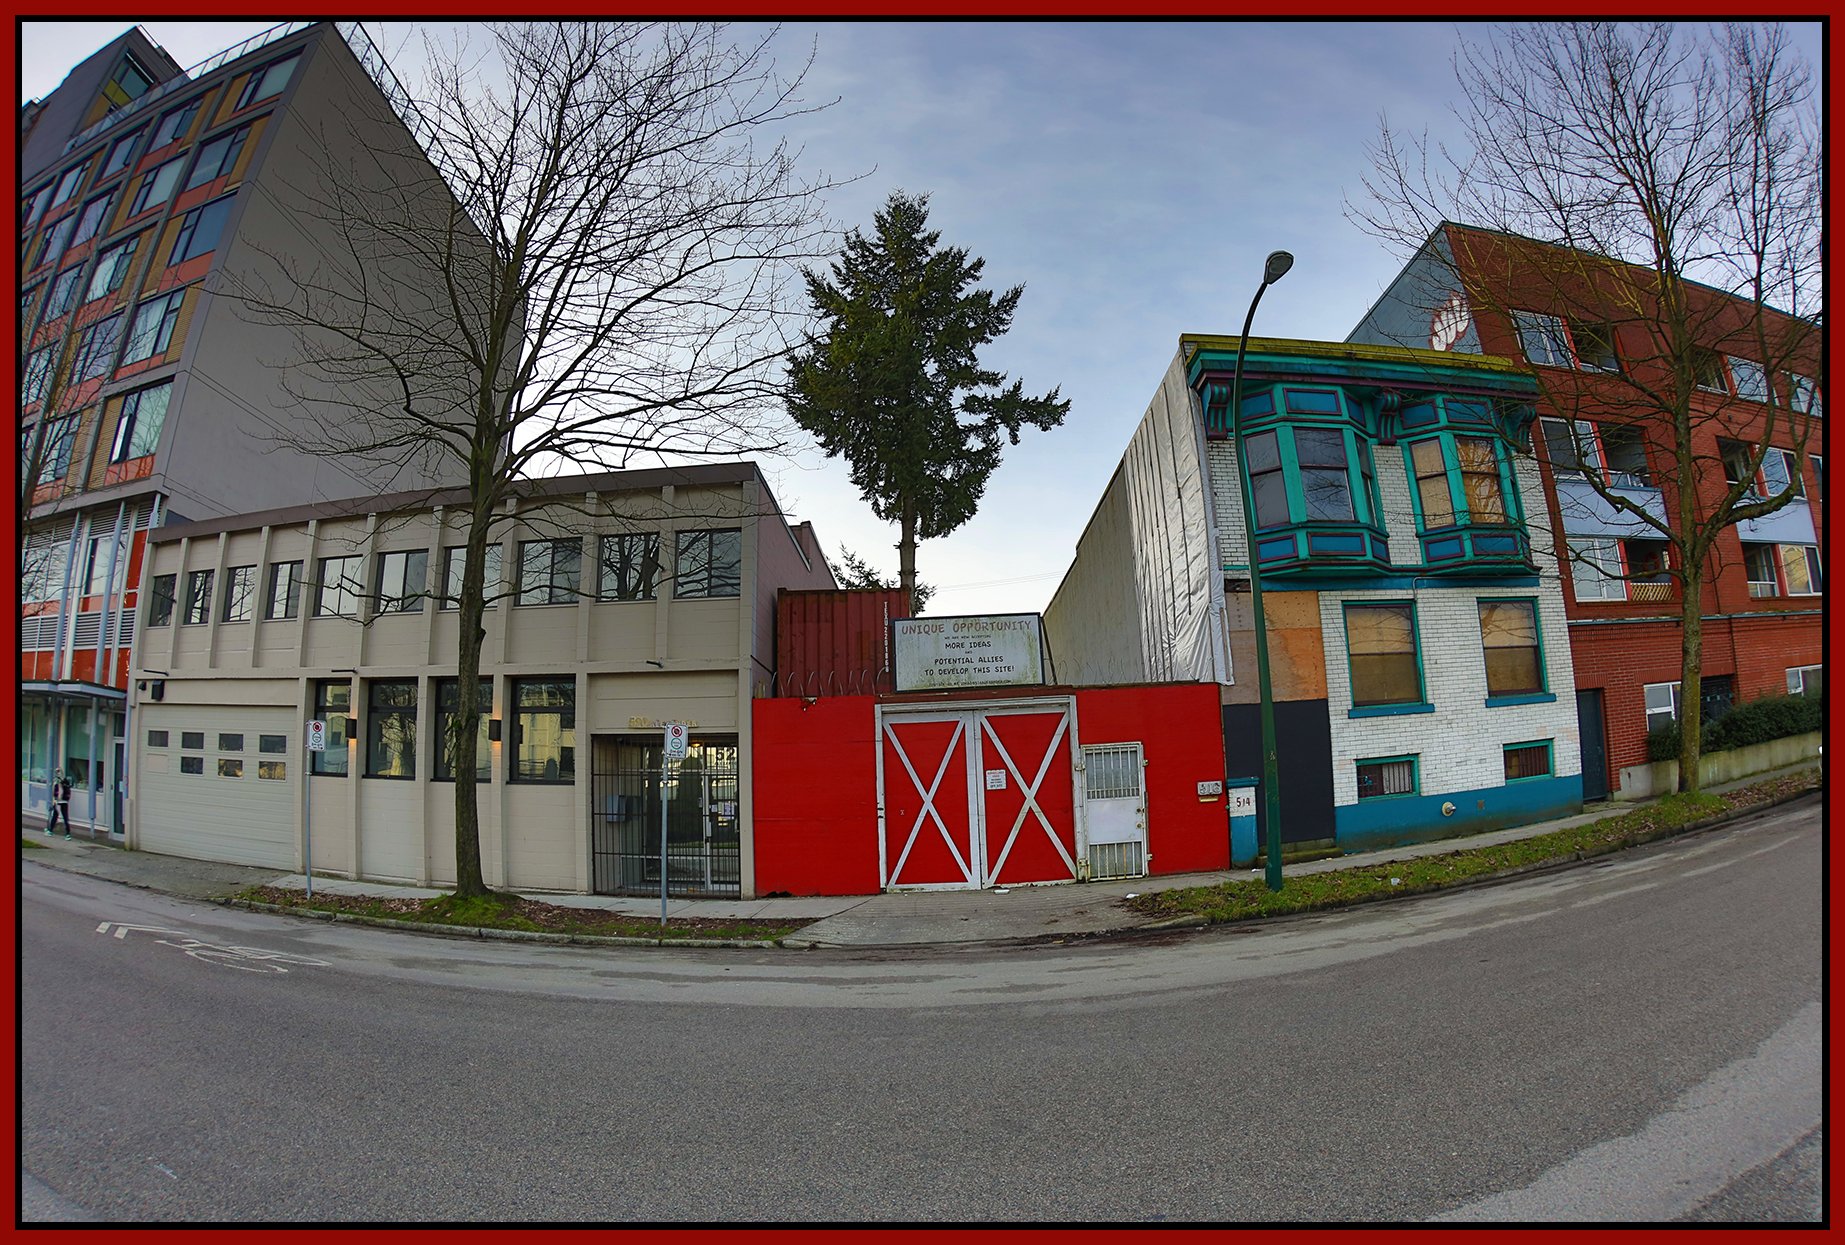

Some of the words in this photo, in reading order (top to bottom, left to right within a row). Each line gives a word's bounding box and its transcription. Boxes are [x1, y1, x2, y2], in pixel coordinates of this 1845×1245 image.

[901, 623, 945, 635] UNIQUE
[952, 620, 1031, 633] OPPORTUNITY
[969, 640, 992, 649] IDEAS
[934, 657, 974, 665] POTENTIAL
[978, 655, 1004, 663] ALLIES
[938, 667, 969, 675] DEVELOP
[995, 665, 1015, 673] SITE!
[1236, 797, 1251, 807] 514
